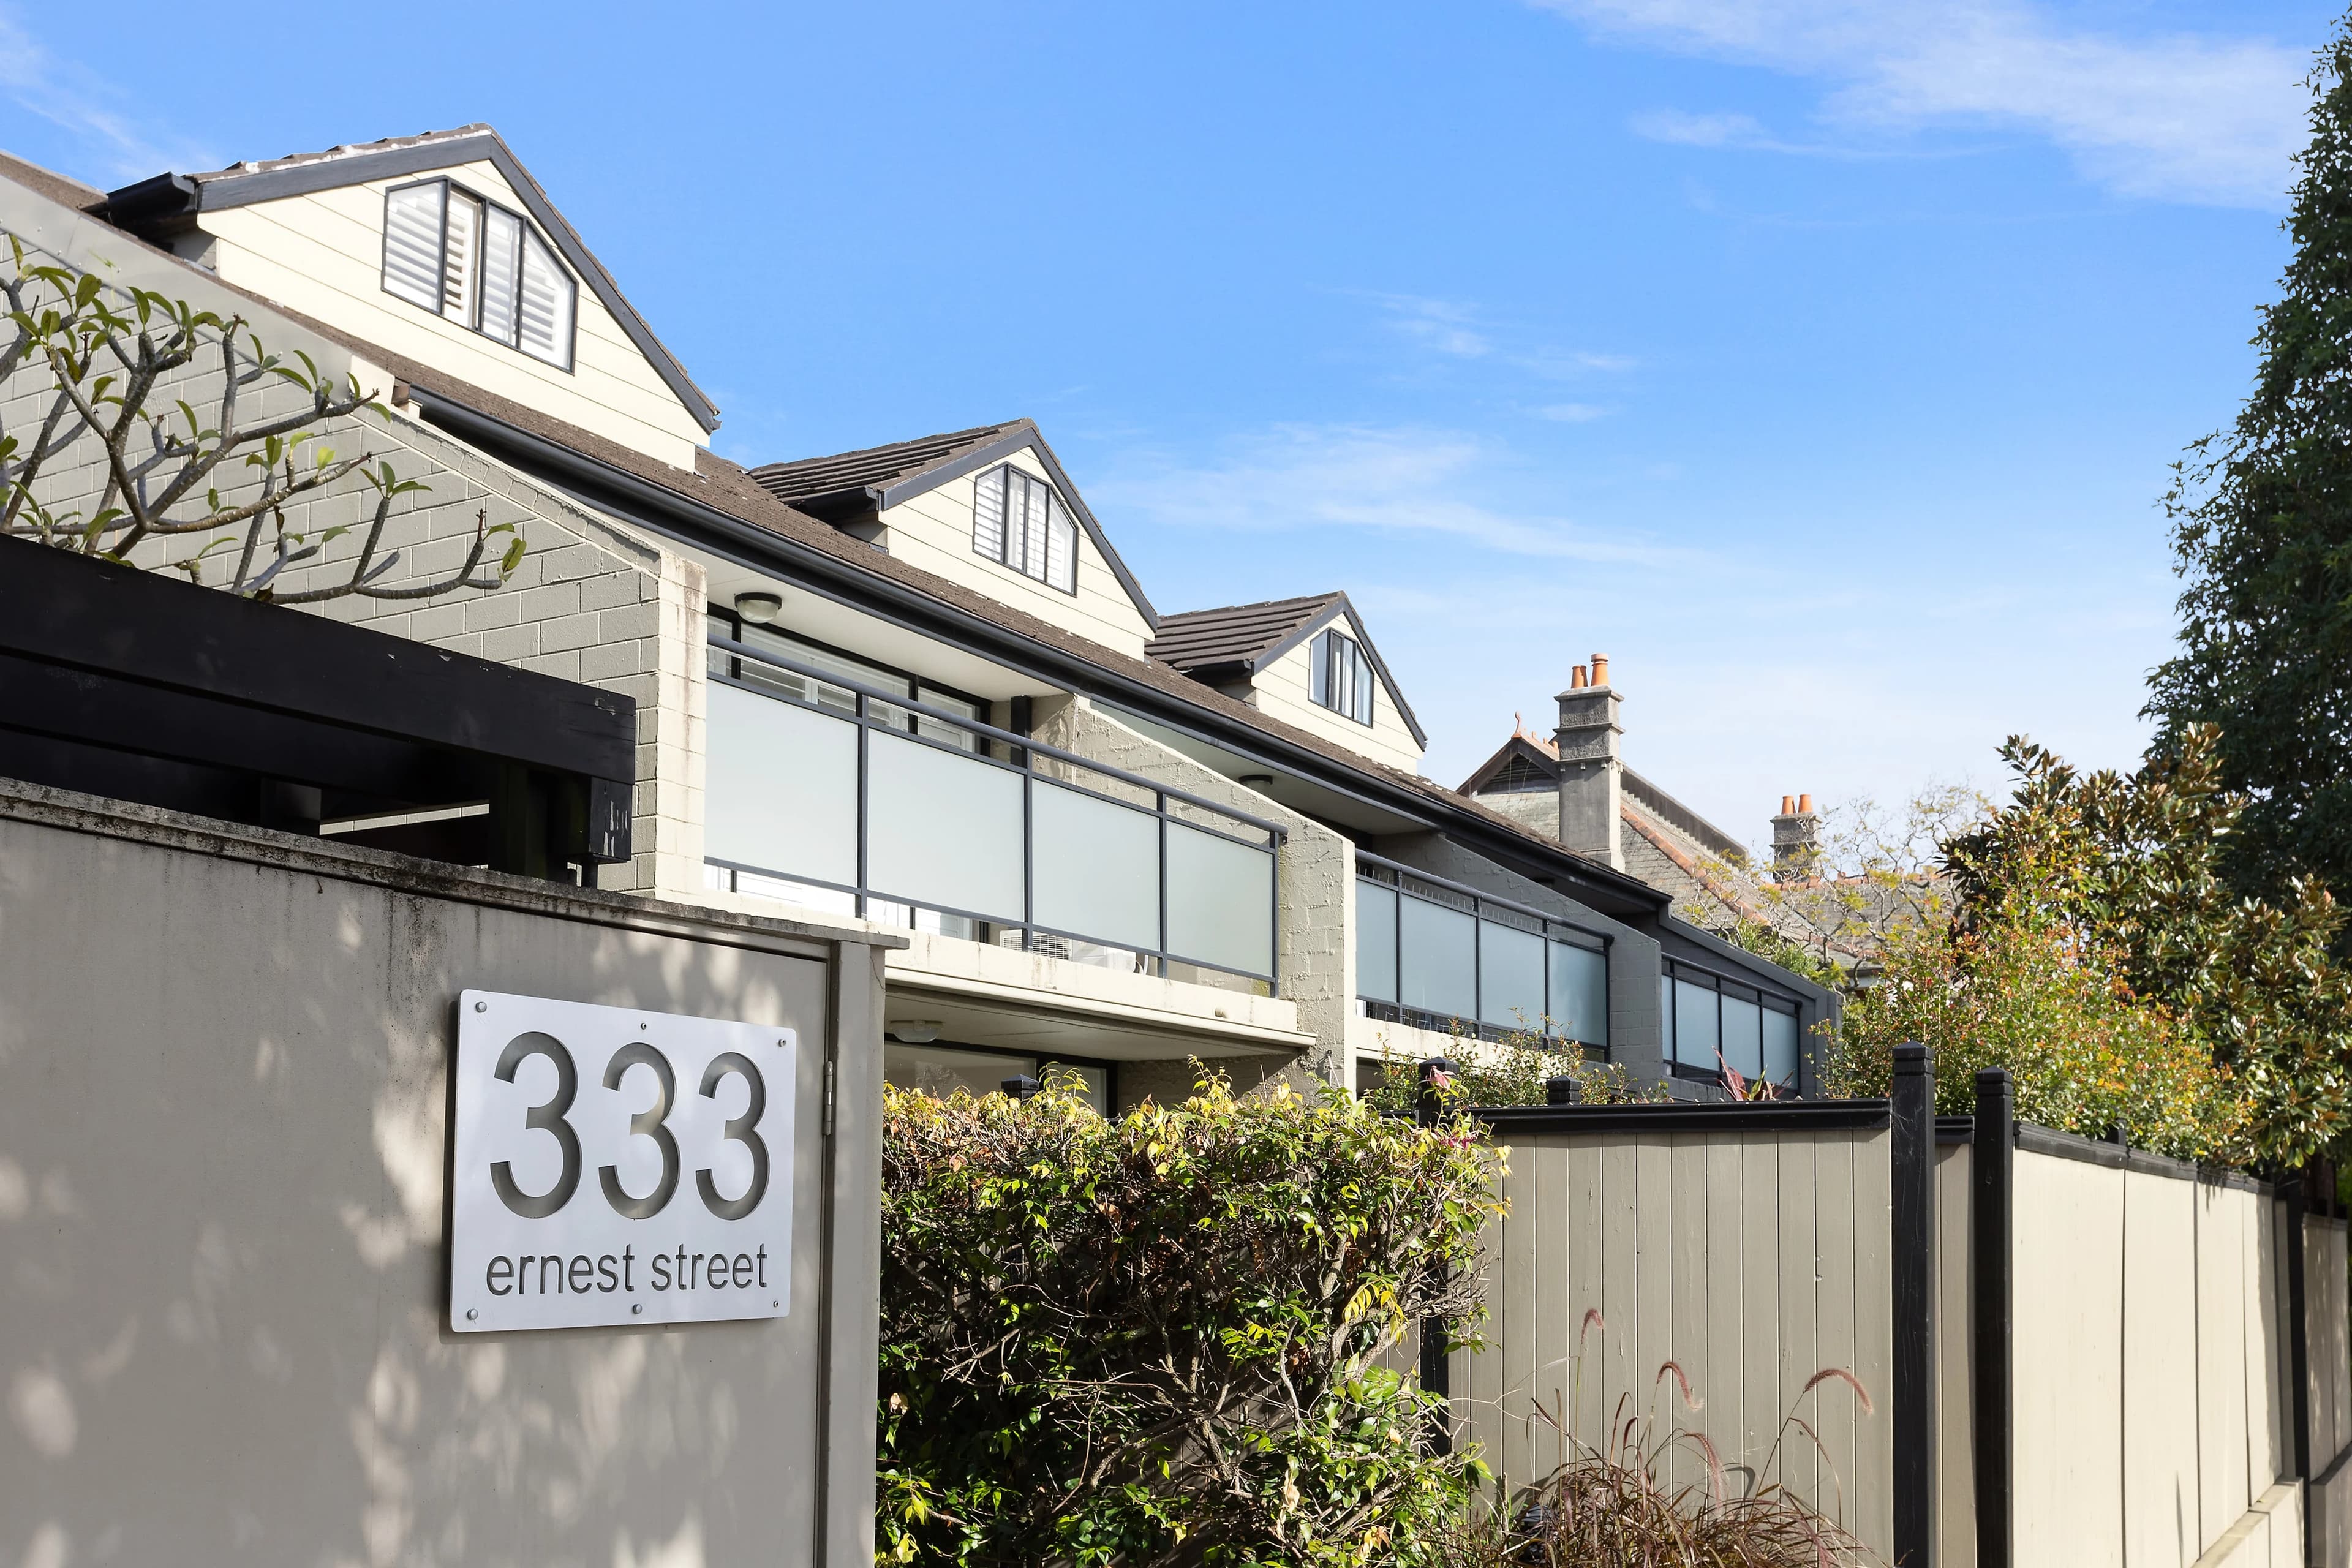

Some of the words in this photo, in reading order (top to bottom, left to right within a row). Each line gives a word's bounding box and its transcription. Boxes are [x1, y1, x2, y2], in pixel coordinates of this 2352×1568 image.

[490, 1031, 771, 1220] 333
[486, 1243, 635, 1296] ernest
[651, 1243, 767, 1292] street
